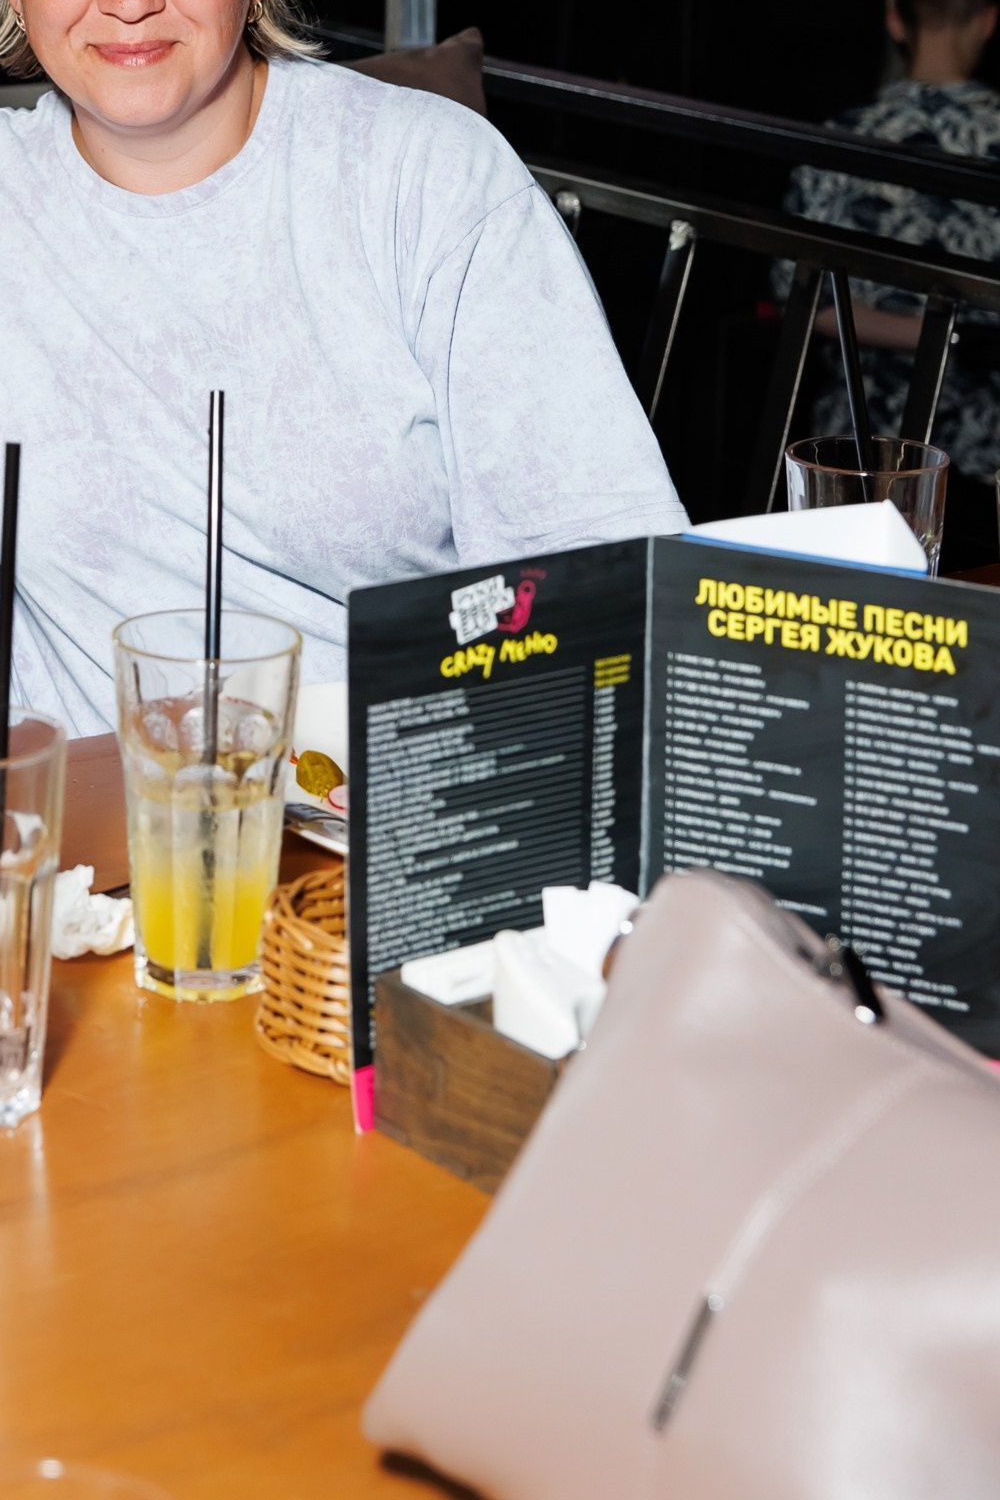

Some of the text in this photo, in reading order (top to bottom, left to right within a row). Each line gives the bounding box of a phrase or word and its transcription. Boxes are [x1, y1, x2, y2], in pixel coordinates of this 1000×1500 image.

[694, 578, 968, 648] ЛЮБИМЫЕ ПЕСНИ
[707, 609, 956, 675] СЕРГЕЯ ЖУКОВА
